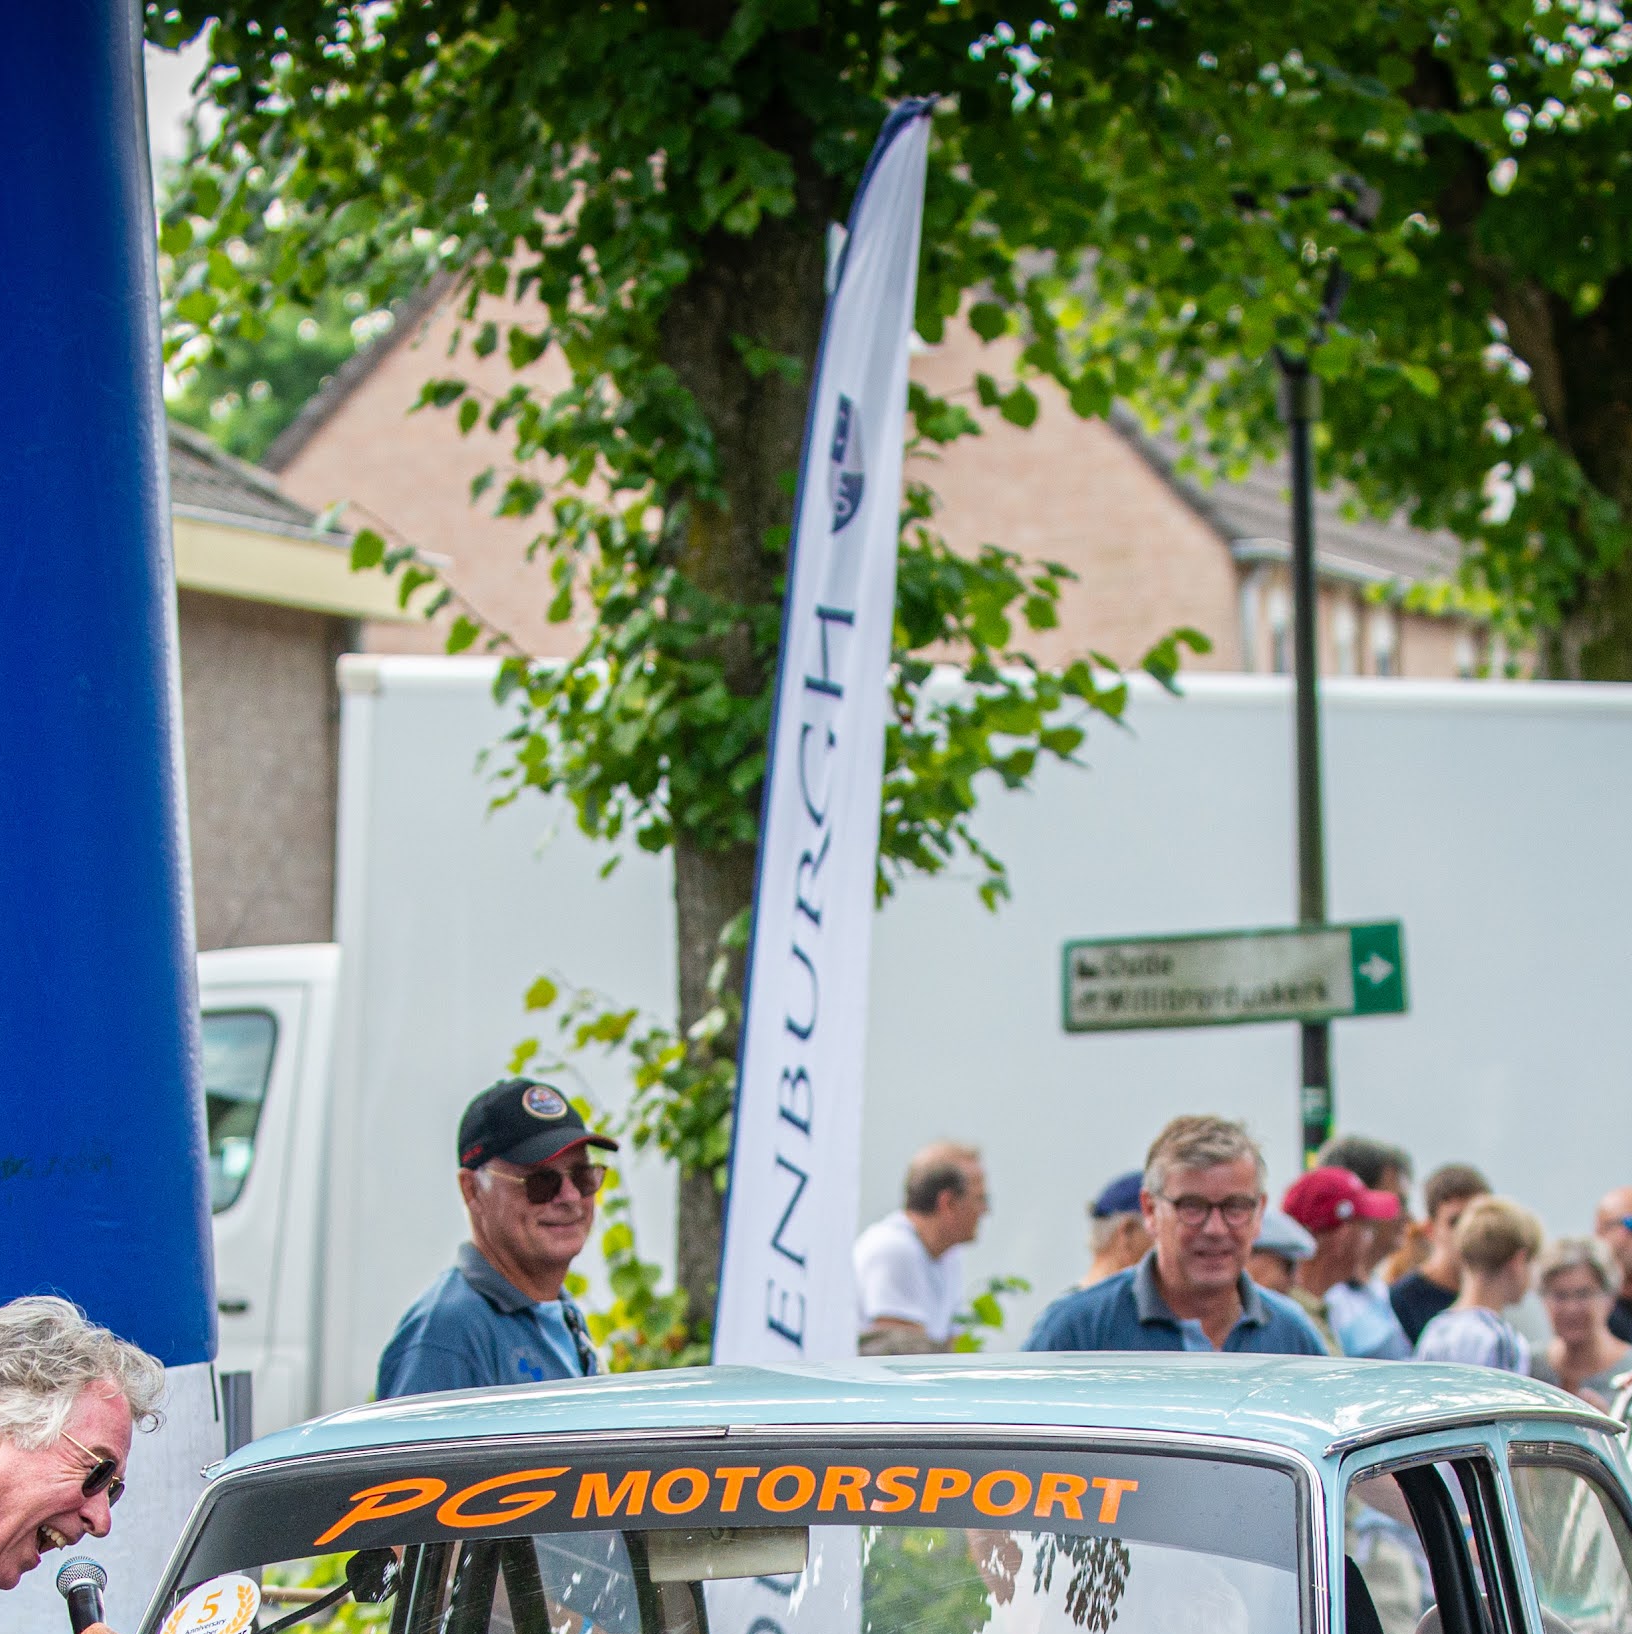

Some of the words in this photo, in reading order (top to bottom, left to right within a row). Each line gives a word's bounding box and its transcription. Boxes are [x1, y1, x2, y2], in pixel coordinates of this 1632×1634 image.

[314, 1466, 572, 1546] PG
[571, 1465, 1139, 1524] MOTORSPORT
[196, 1589, 224, 1624] 5
